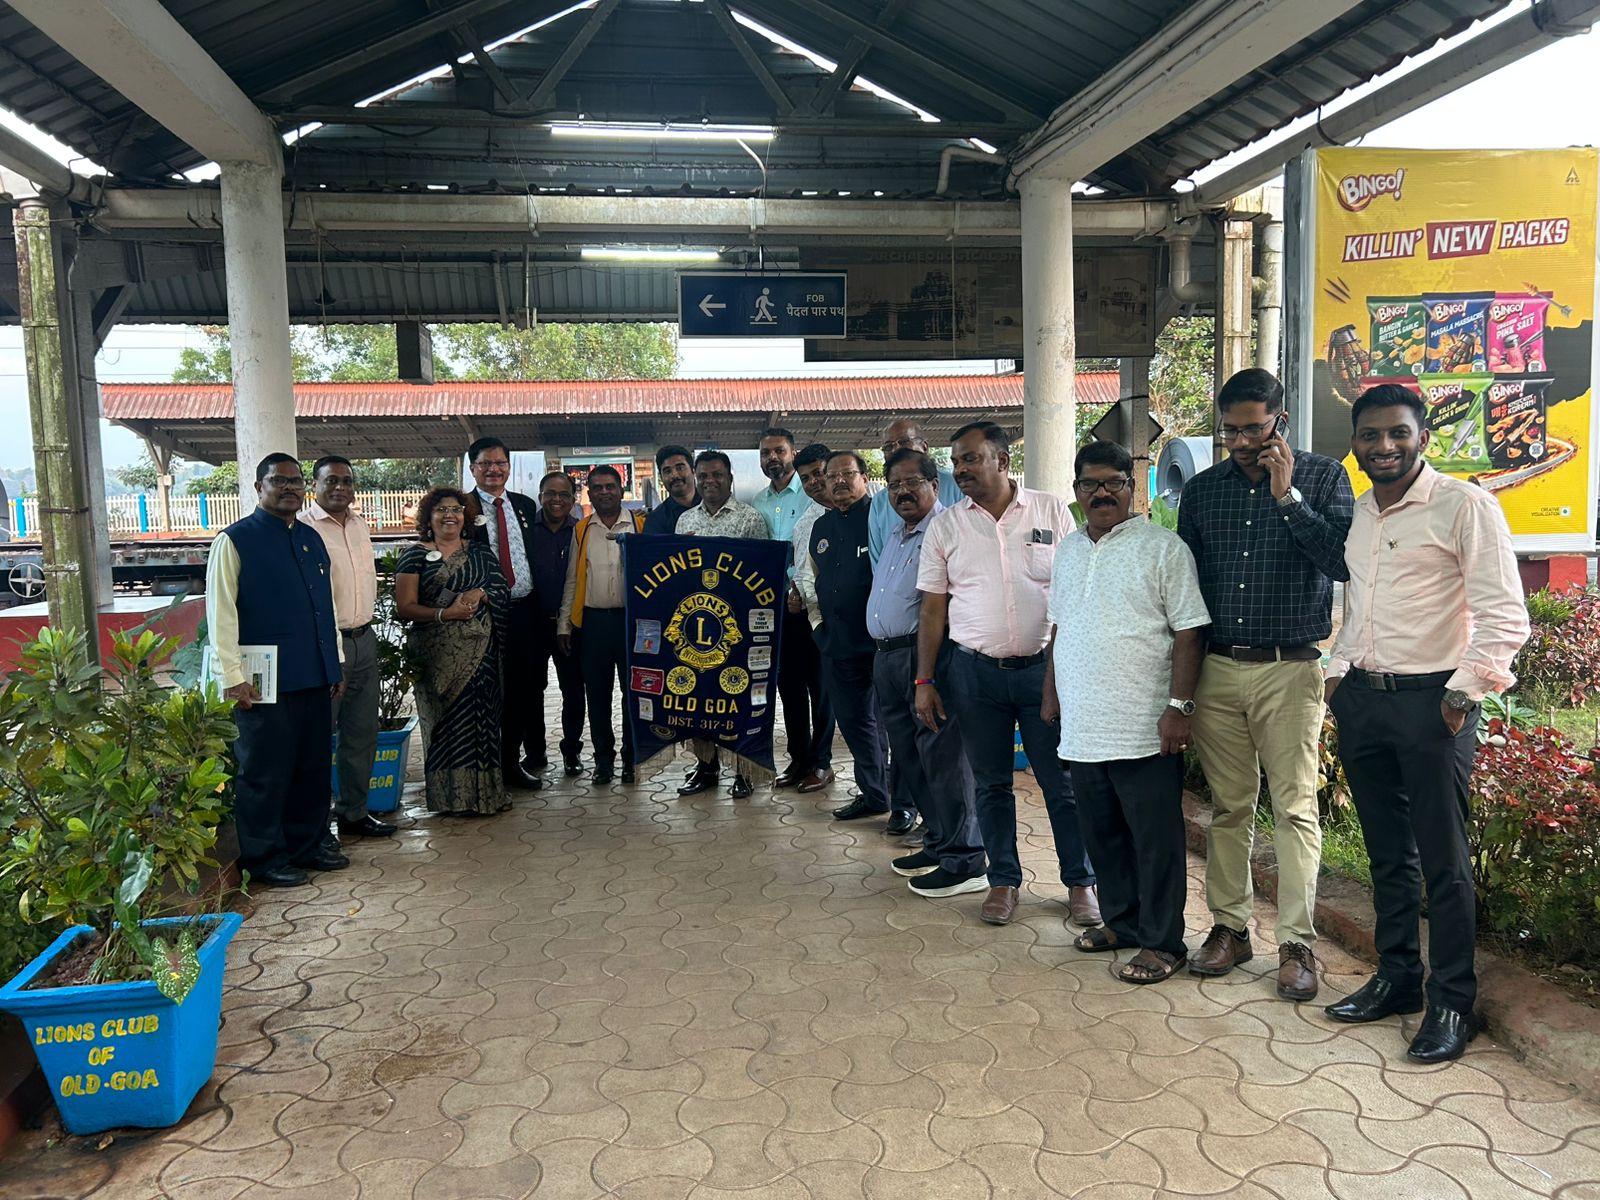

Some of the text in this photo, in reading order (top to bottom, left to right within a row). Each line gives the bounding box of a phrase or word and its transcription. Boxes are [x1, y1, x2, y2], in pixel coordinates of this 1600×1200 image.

[1342, 168, 1405, 205] BINGO!
[1344, 218, 1569, 262] KILLIN' NEW PACKS
[806, 294, 825, 303] FOB
[786, 303, 845, 317] पैदल पार पथ
[1378, 303, 1409, 321] BINGO!
[1434, 301, 1467, 320] BINGO!
[1492, 301, 1524, 320] BINGO!
[1516, 316, 1535, 331] SALT
[1429, 381, 1463, 401] BINGO!
[1492, 380, 1525, 401] BINGO!
[634, 548, 776, 606] LIONS CLUB
[683, 595, 728, 616] LIONS
[696, 617, 713, 646] L
[668, 668, 678, 682] NEW
[679, 667, 694, 678] CLUB
[721, 667, 748, 680] NEW CLUB
[669, 680, 695, 693] SPONSOR
[721, 680, 747, 693] SPONSOR
[662, 694, 697, 712] OLD
[705, 698, 738, 714] GOA
[668, 715, 734, 730] DIST. 317-B
[375, 749, 399, 762] LUB
[35, 1014, 160, 1045] LIONS CLUB
[88, 1046, 115, 1066] OF
